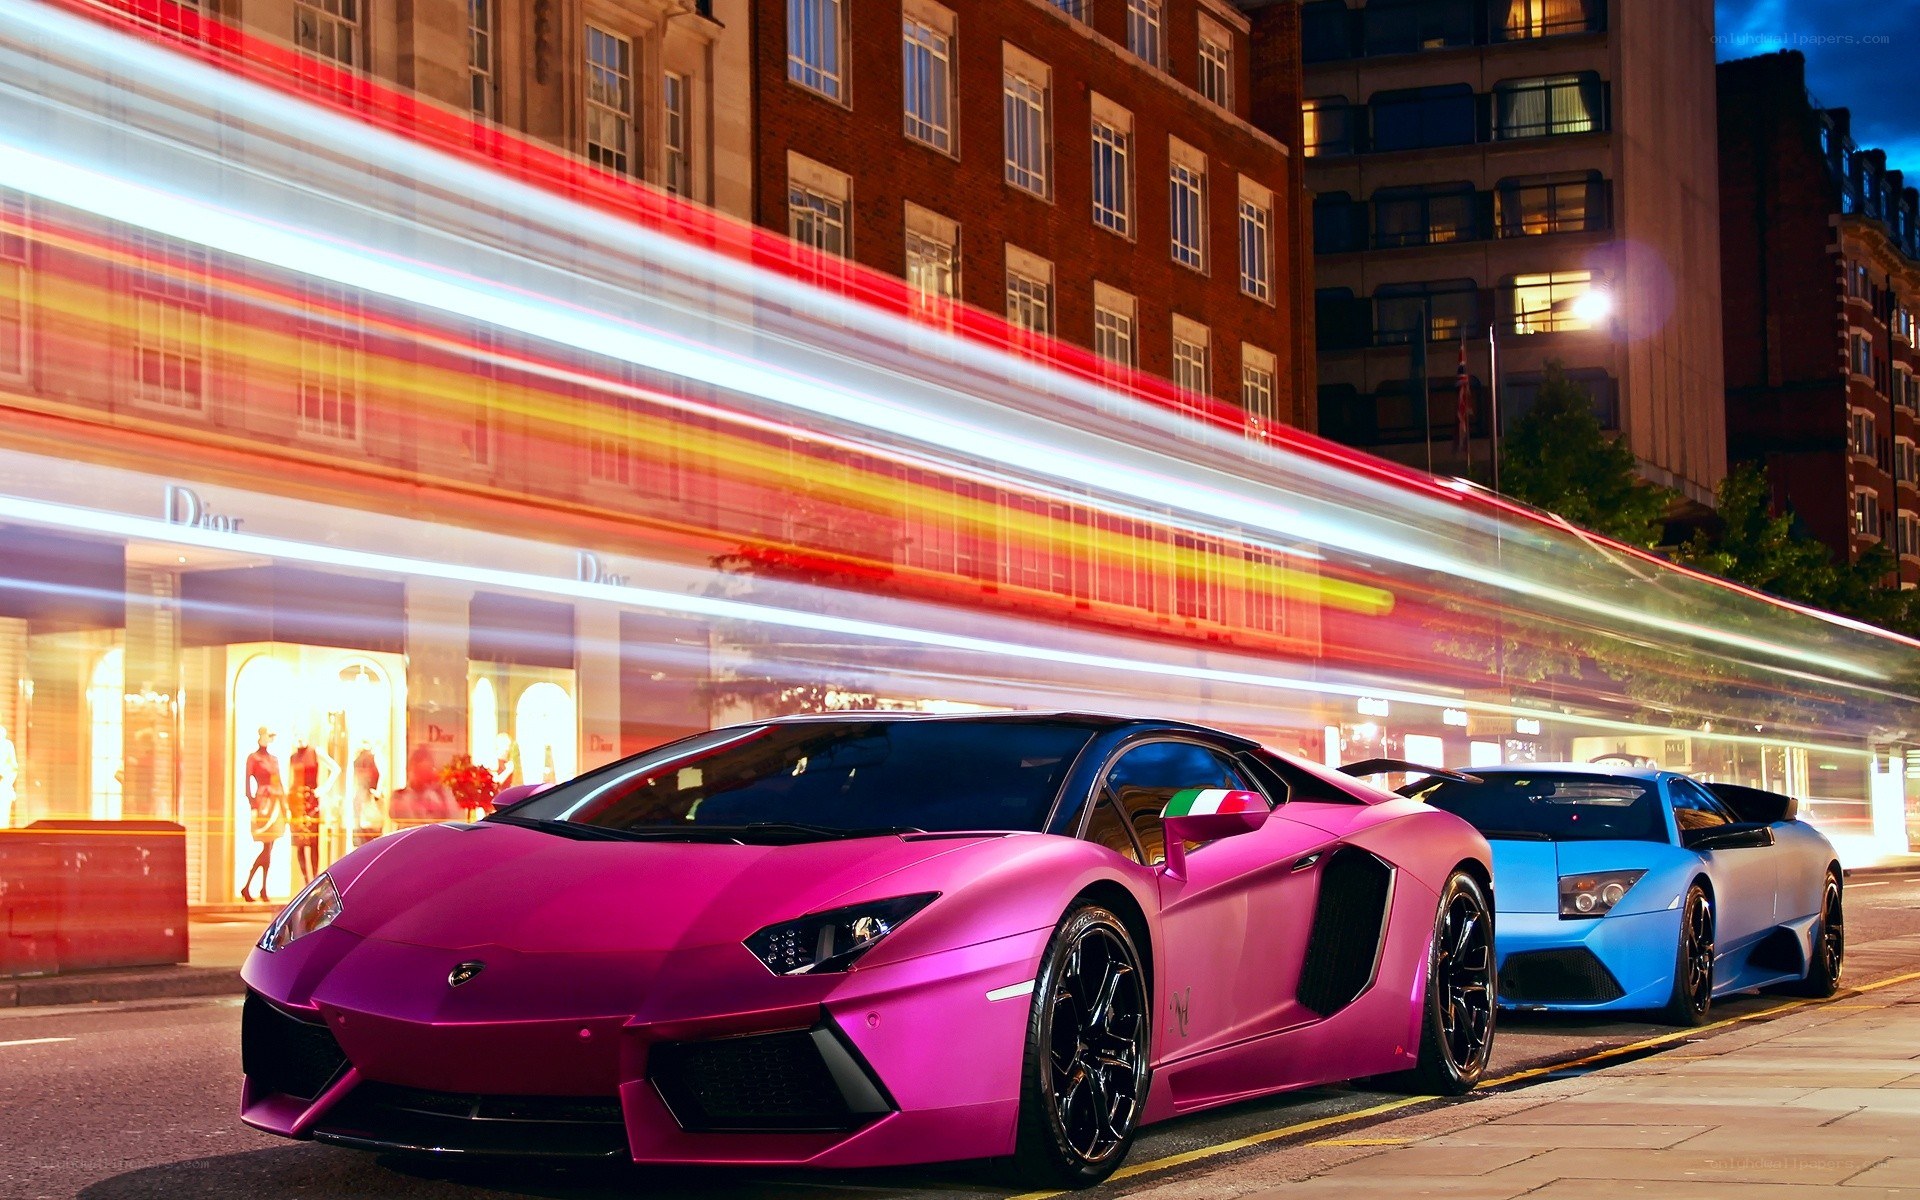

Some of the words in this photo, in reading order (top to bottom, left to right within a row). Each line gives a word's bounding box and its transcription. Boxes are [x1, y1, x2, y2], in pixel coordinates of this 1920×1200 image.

[165, 484, 245, 534] Dior
[576, 551, 630, 587] Dior
[428, 724, 454, 743] Dior
